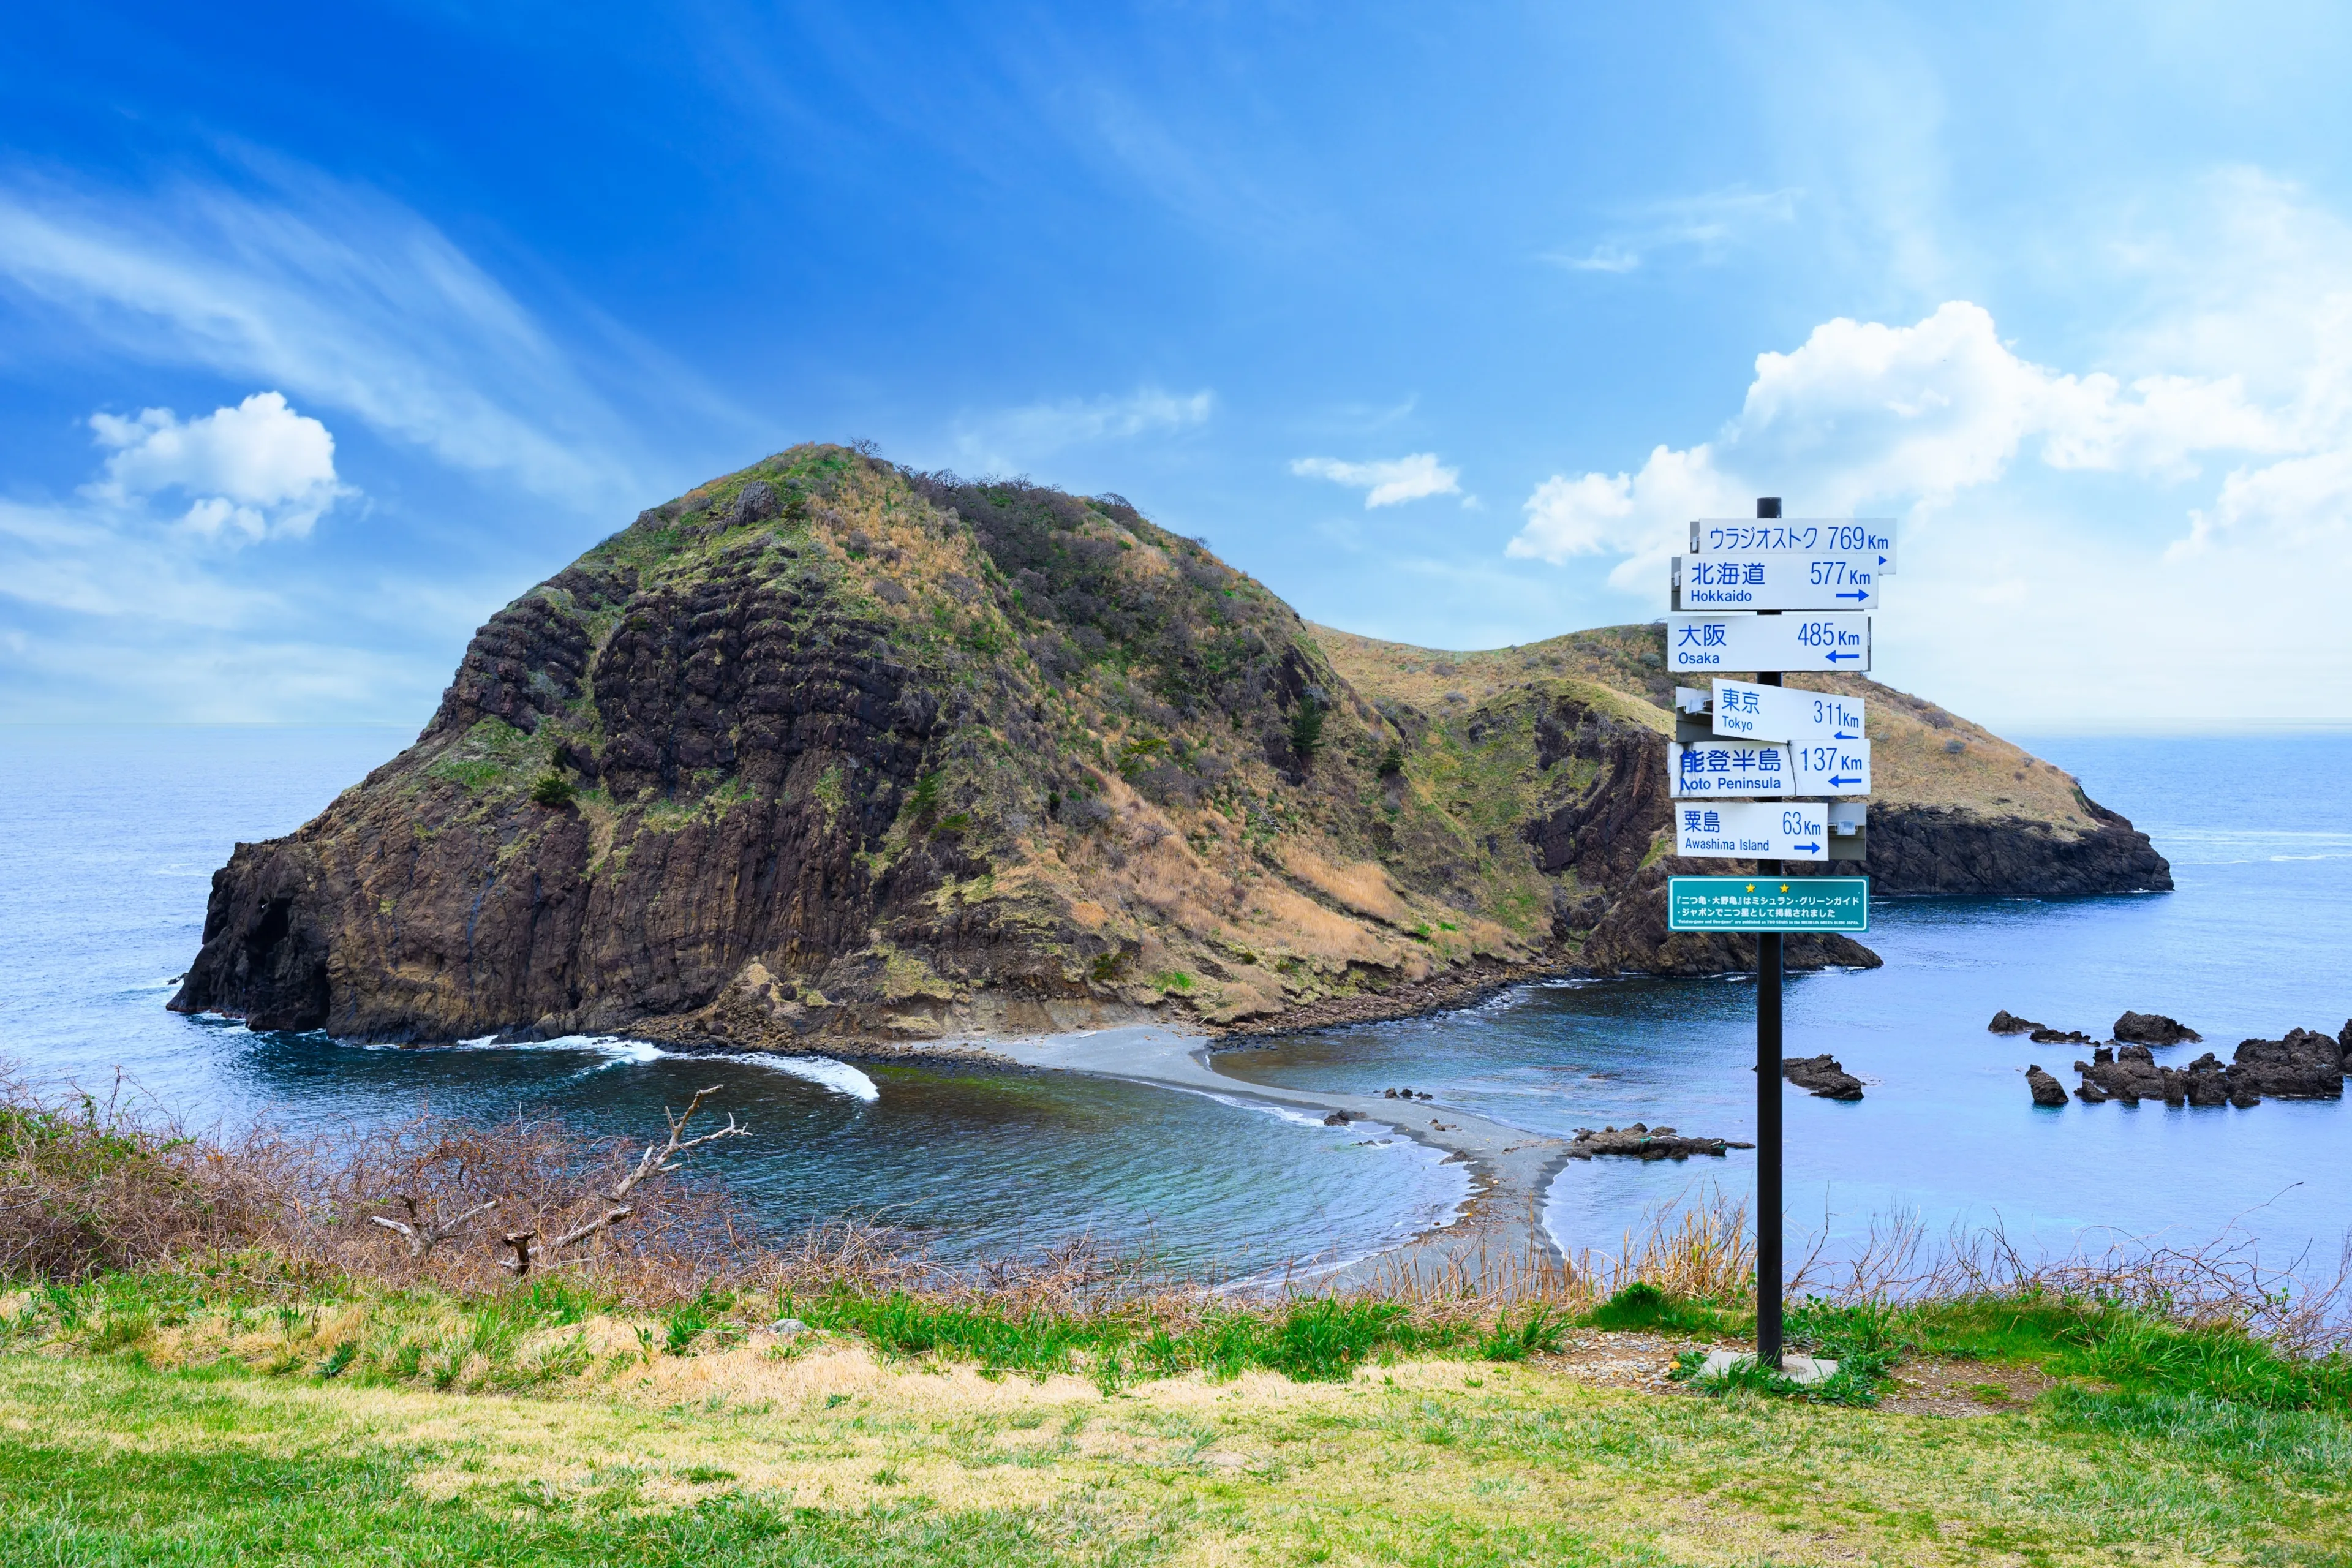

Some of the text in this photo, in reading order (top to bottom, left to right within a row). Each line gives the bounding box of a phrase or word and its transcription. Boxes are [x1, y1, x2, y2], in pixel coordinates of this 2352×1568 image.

[1710, 526, 1818, 549] ウラジオストク
[1691, 562, 1765, 586] 北海道
[1690, 589, 1753, 603] Hokkaido
[1678, 624, 1727, 647] 大阪
[1678, 651, 1721, 665] Osaka
[1721, 688, 1760, 715] 東京
[1722, 715, 1754, 732] Tokyo
[1680, 748, 1782, 774] 能登半島
[1717, 776, 1782, 790] Peninsula
[1684, 810, 1721, 834] 粟島
[1685, 837, 1770, 851] Awashima Island
